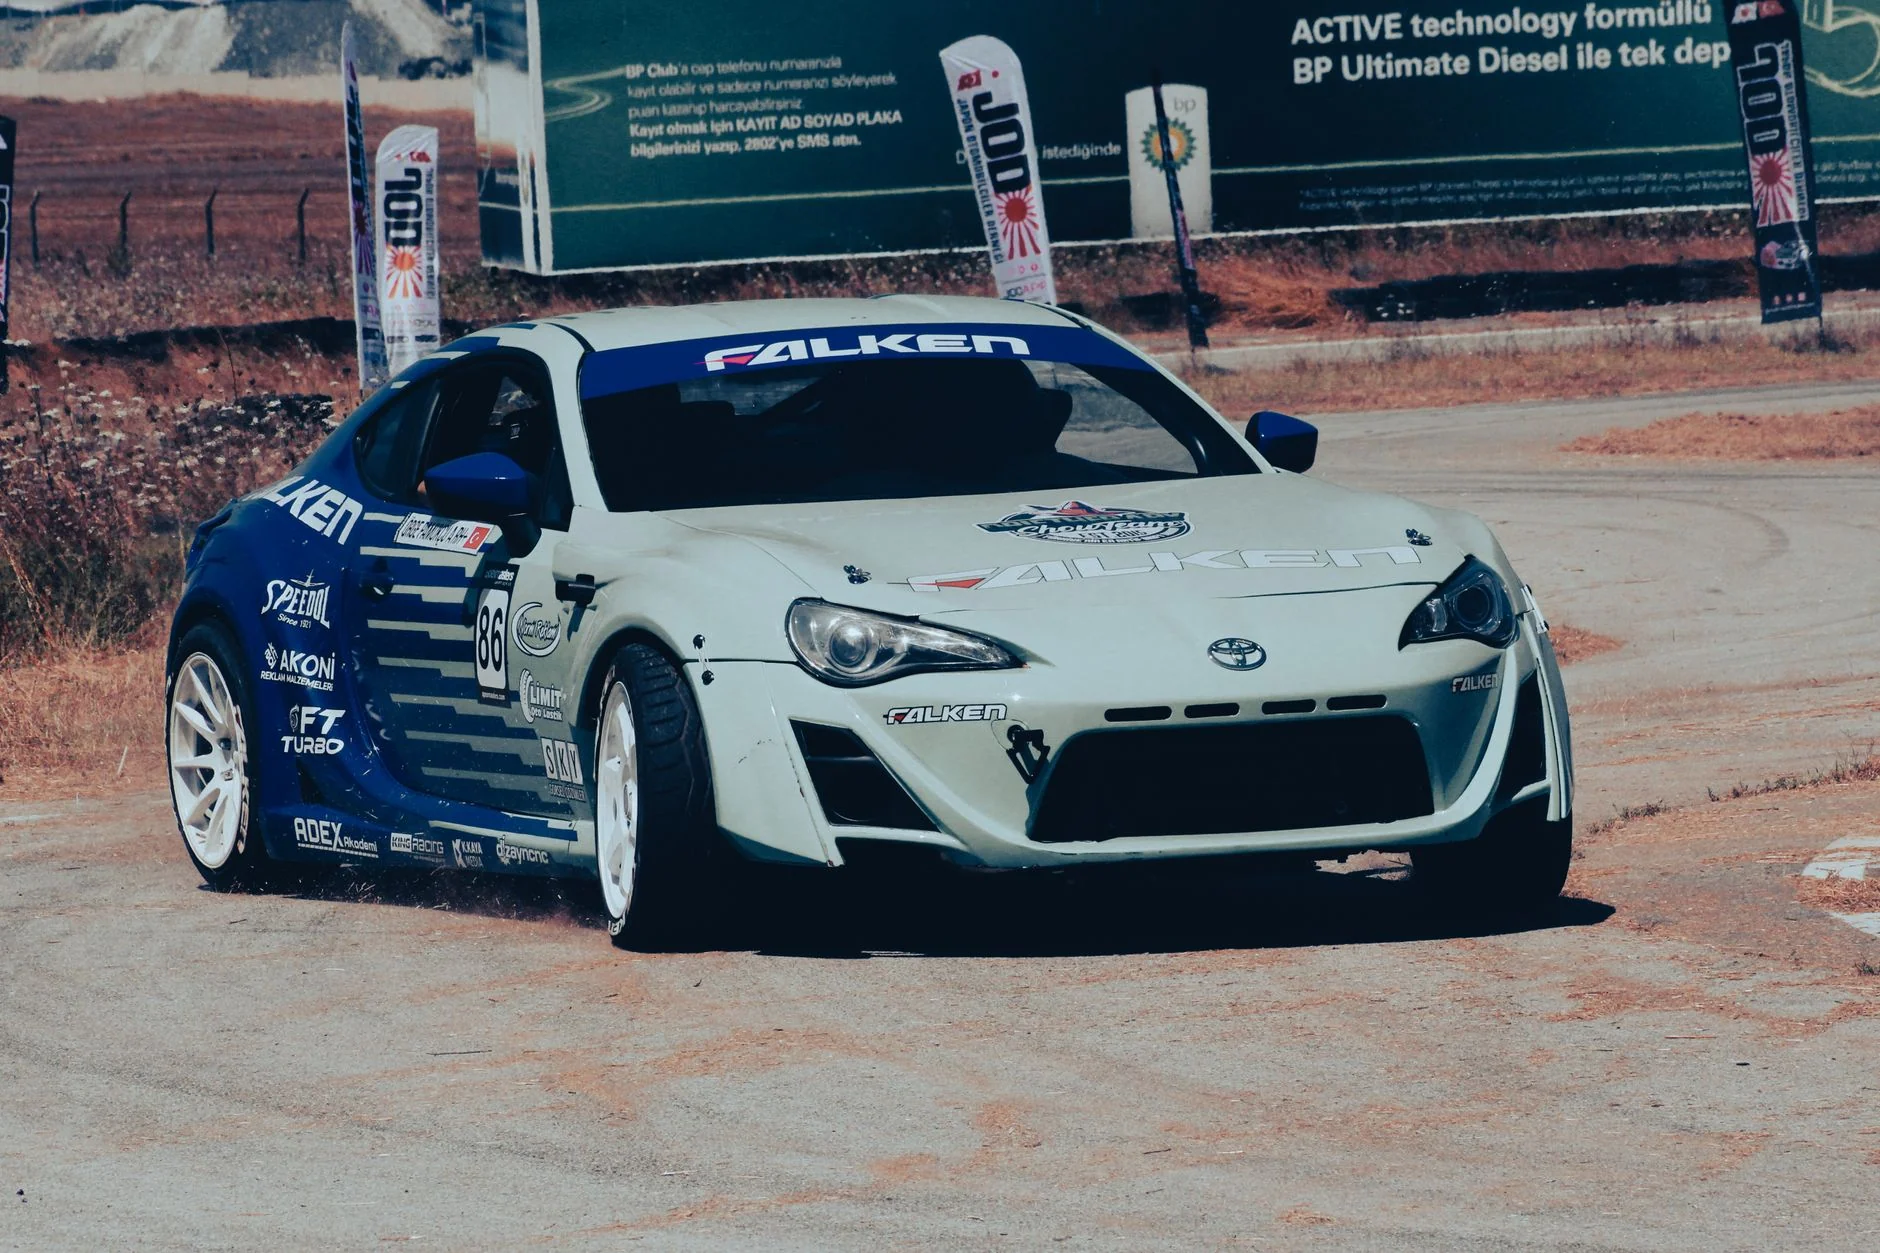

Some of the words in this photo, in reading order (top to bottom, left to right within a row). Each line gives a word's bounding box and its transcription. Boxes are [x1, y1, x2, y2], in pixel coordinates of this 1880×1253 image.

[1292, 13, 1403, 45] ACTIVE
[1411, 6, 1577, 39] technology
[1586, 0, 1712, 29] formüllü
[626, 65, 644, 79] BP
[647, 62, 687, 78] Club'a
[691, 63, 713, 76] cep
[717, 59, 767, 74] telefonu
[1293, 57, 1332, 84] BP
[1341, 48, 1470, 82] Ultimate
[1479, 46, 1568, 74] Diesel
[1577, 42, 1611, 69] ile
[1618, 40, 1665, 66] tek
[1679, 38, 1732, 70] dep
[700, 83, 714, 94] ve
[717, 79, 761, 93] sadece
[628, 105, 659, 120] puan
[1173, 96, 1196, 114] bp
[630, 123, 664, 139] Kayıt
[666, 120, 707, 135] olmak
[736, 116, 777, 131] KAYIT
[780, 115, 801, 130] AD
[804, 112, 854, 129] SOYAD
[857, 110, 902, 126] PLAKA
[631, 139, 701, 159] bilgilerinizi
[797, 133, 829, 148] SMS
[972, 91, 1031, 194] JOD
[704, 334, 1030, 372] FALKEN
[258, 476, 363, 546] LKEN
[907, 546, 1421, 592] FALKEN
[261, 580, 330, 629] SPEEDOL
[278, 613, 298, 626] Since
[478, 605, 504, 672] 86
[261, 671, 285, 682] REKLAM
[1452, 673, 1498, 692] FALKEN
[301, 706, 346, 735] FT
[886, 704, 1008, 725] FALKEN
[281, 736, 345, 755] TURBO
[546, 745, 578, 779] SKY
[294, 817, 344, 851] ADEX
[391, 836, 411, 848] KING
